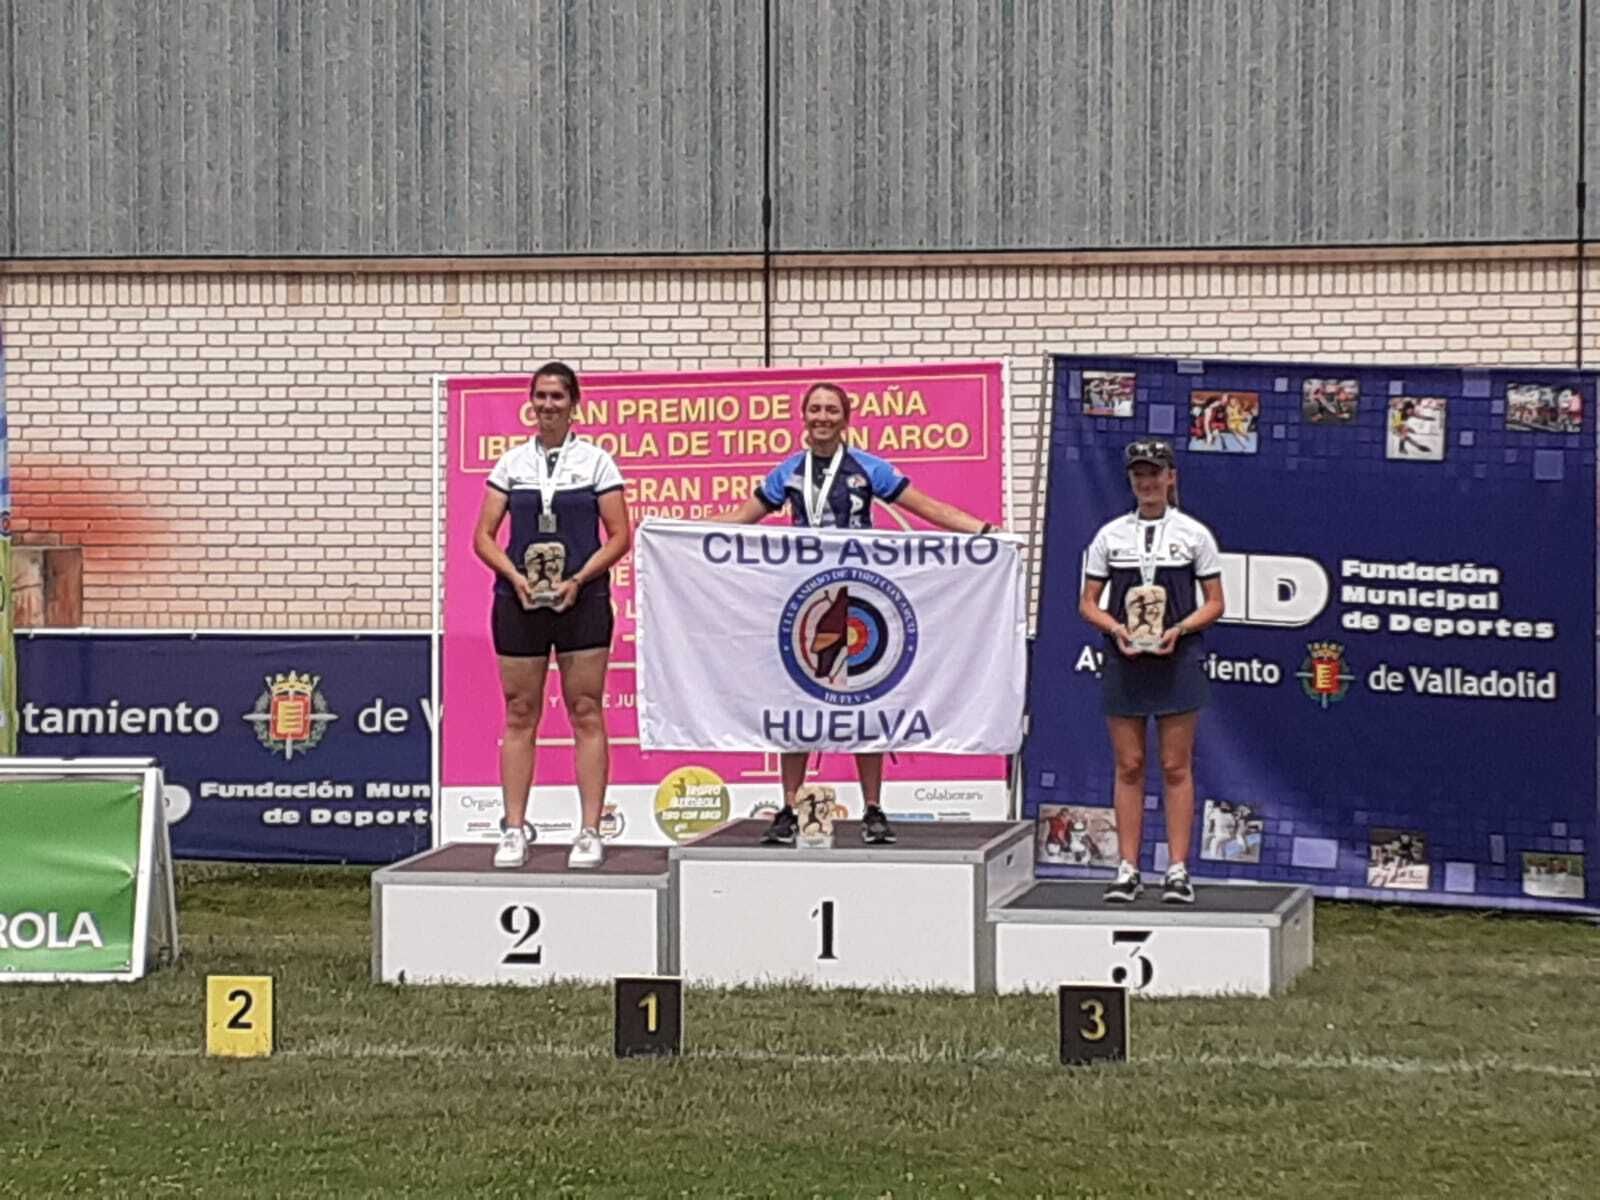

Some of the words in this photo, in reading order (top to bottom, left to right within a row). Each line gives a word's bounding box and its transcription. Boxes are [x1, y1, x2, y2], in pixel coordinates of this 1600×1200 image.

[519, 400, 608, 426] GAN
[618, 397, 740, 425] PREMIO
[749, 395, 790, 420] DE
[848, 385, 926, 417] PAÑA
[668, 431, 711, 456] DE
[718, 429, 792, 454] TIRO
[879, 422, 970, 450] ARCO
[702, 532, 824, 565] CLUB
[838, 535, 998, 566] ASIRIO
[1341, 559, 1499, 584] Fundación
[1341, 585, 1499, 611] Municipal
[1341, 611, 1380, 630] de
[1388, 613, 1555, 639] Deportes
[1368, 664, 1405, 691] de
[1409, 666, 1556, 699] Valladolid
[20, 700, 219, 734] tamiento
[357, 698, 409, 733] de
[764, 709, 931, 743] HUELVA
[200, 781, 354, 798] Fundación
[262, 808, 300, 824] de
[310, 808, 432, 827] Deport
[500, 905, 542, 964] 2
[811, 901, 839, 960] 1
[1113, 931, 1153, 989] 3
[227, 989, 254, 1030] 2
[637, 991, 658, 1033] 1
[1080, 999, 1106, 1040] 3
